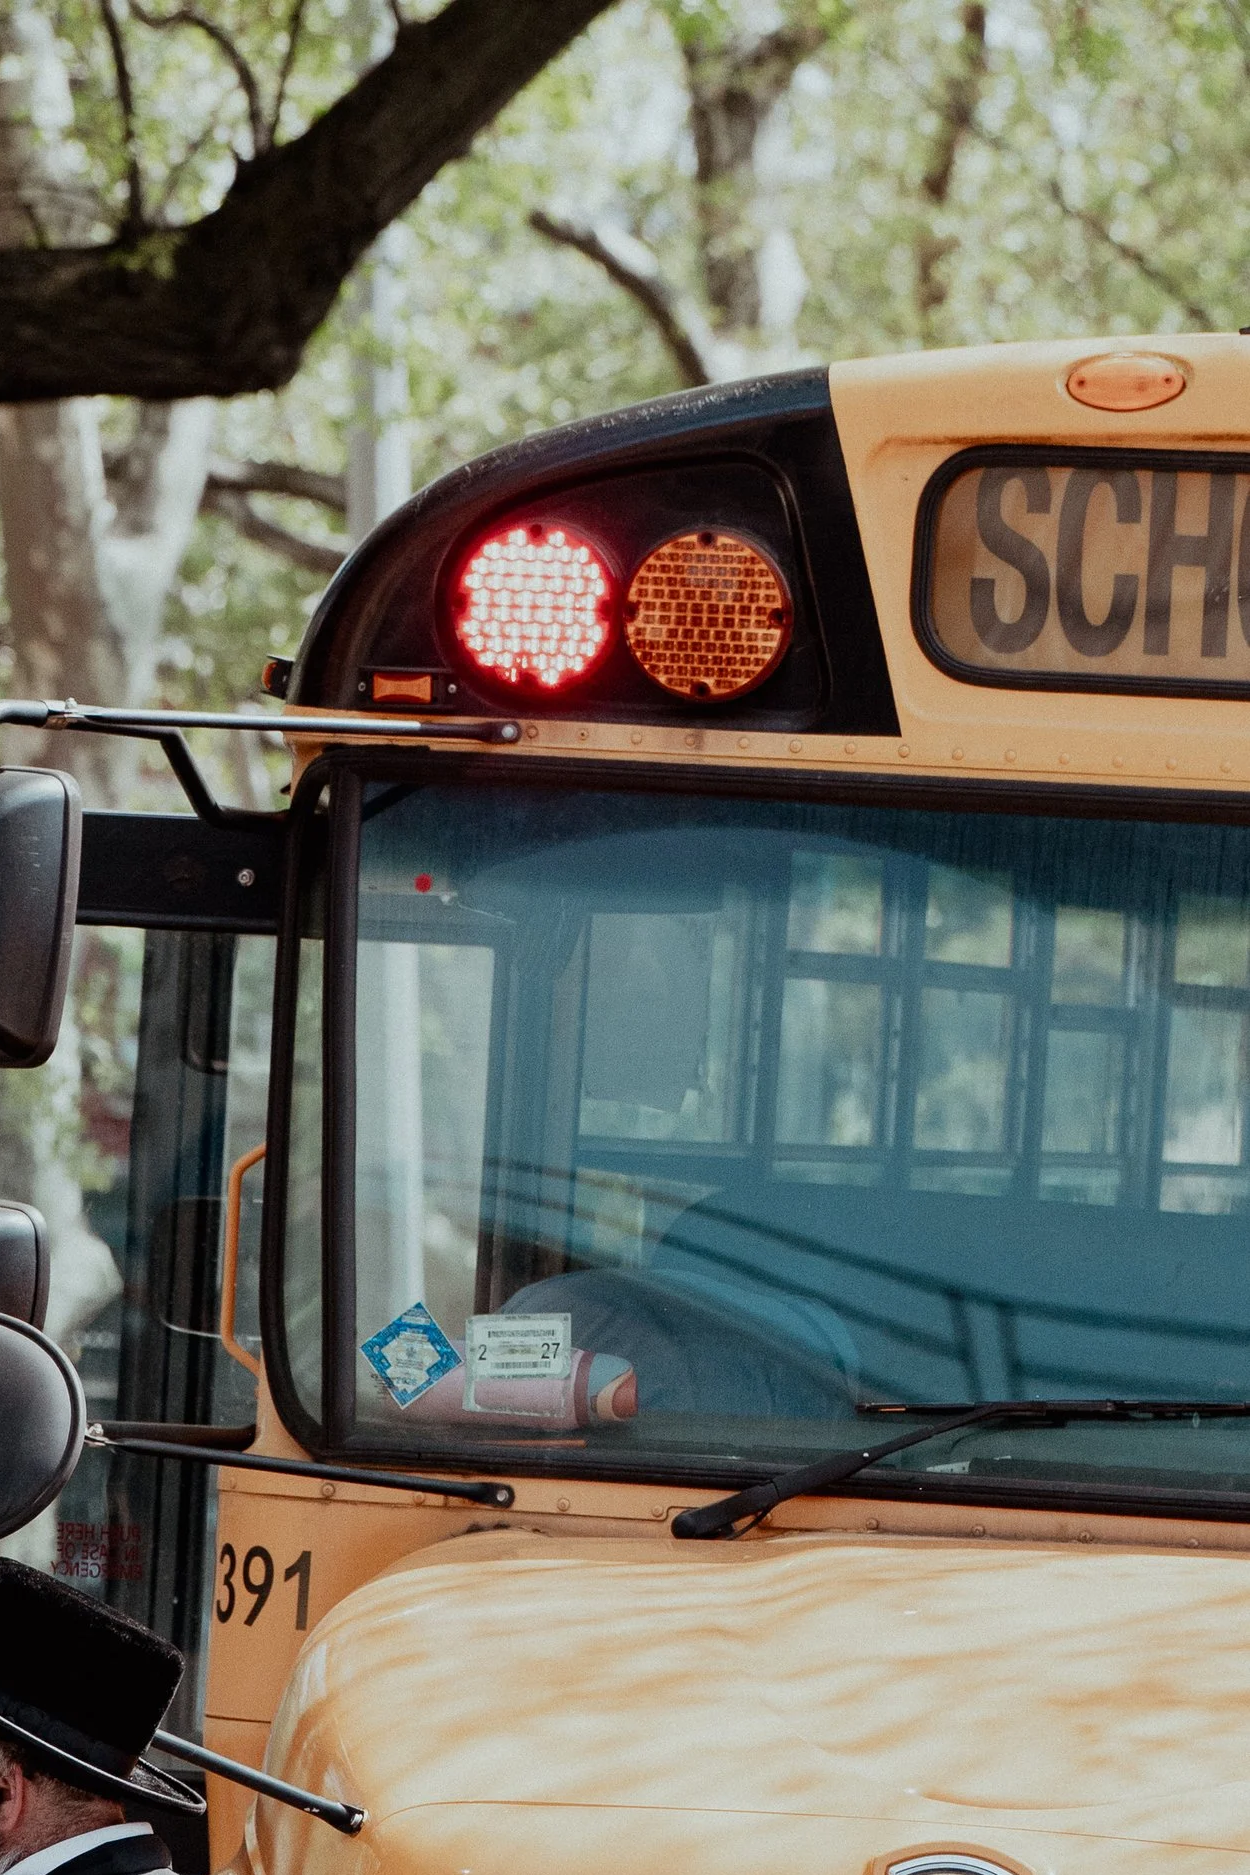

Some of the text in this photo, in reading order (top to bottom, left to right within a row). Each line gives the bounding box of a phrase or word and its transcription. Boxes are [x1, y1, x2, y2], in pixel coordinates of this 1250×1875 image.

[969, 466, 1250, 658] SCH
[477, 1342, 561, 1361] 2 27
[216, 1542, 312, 1632] 391
